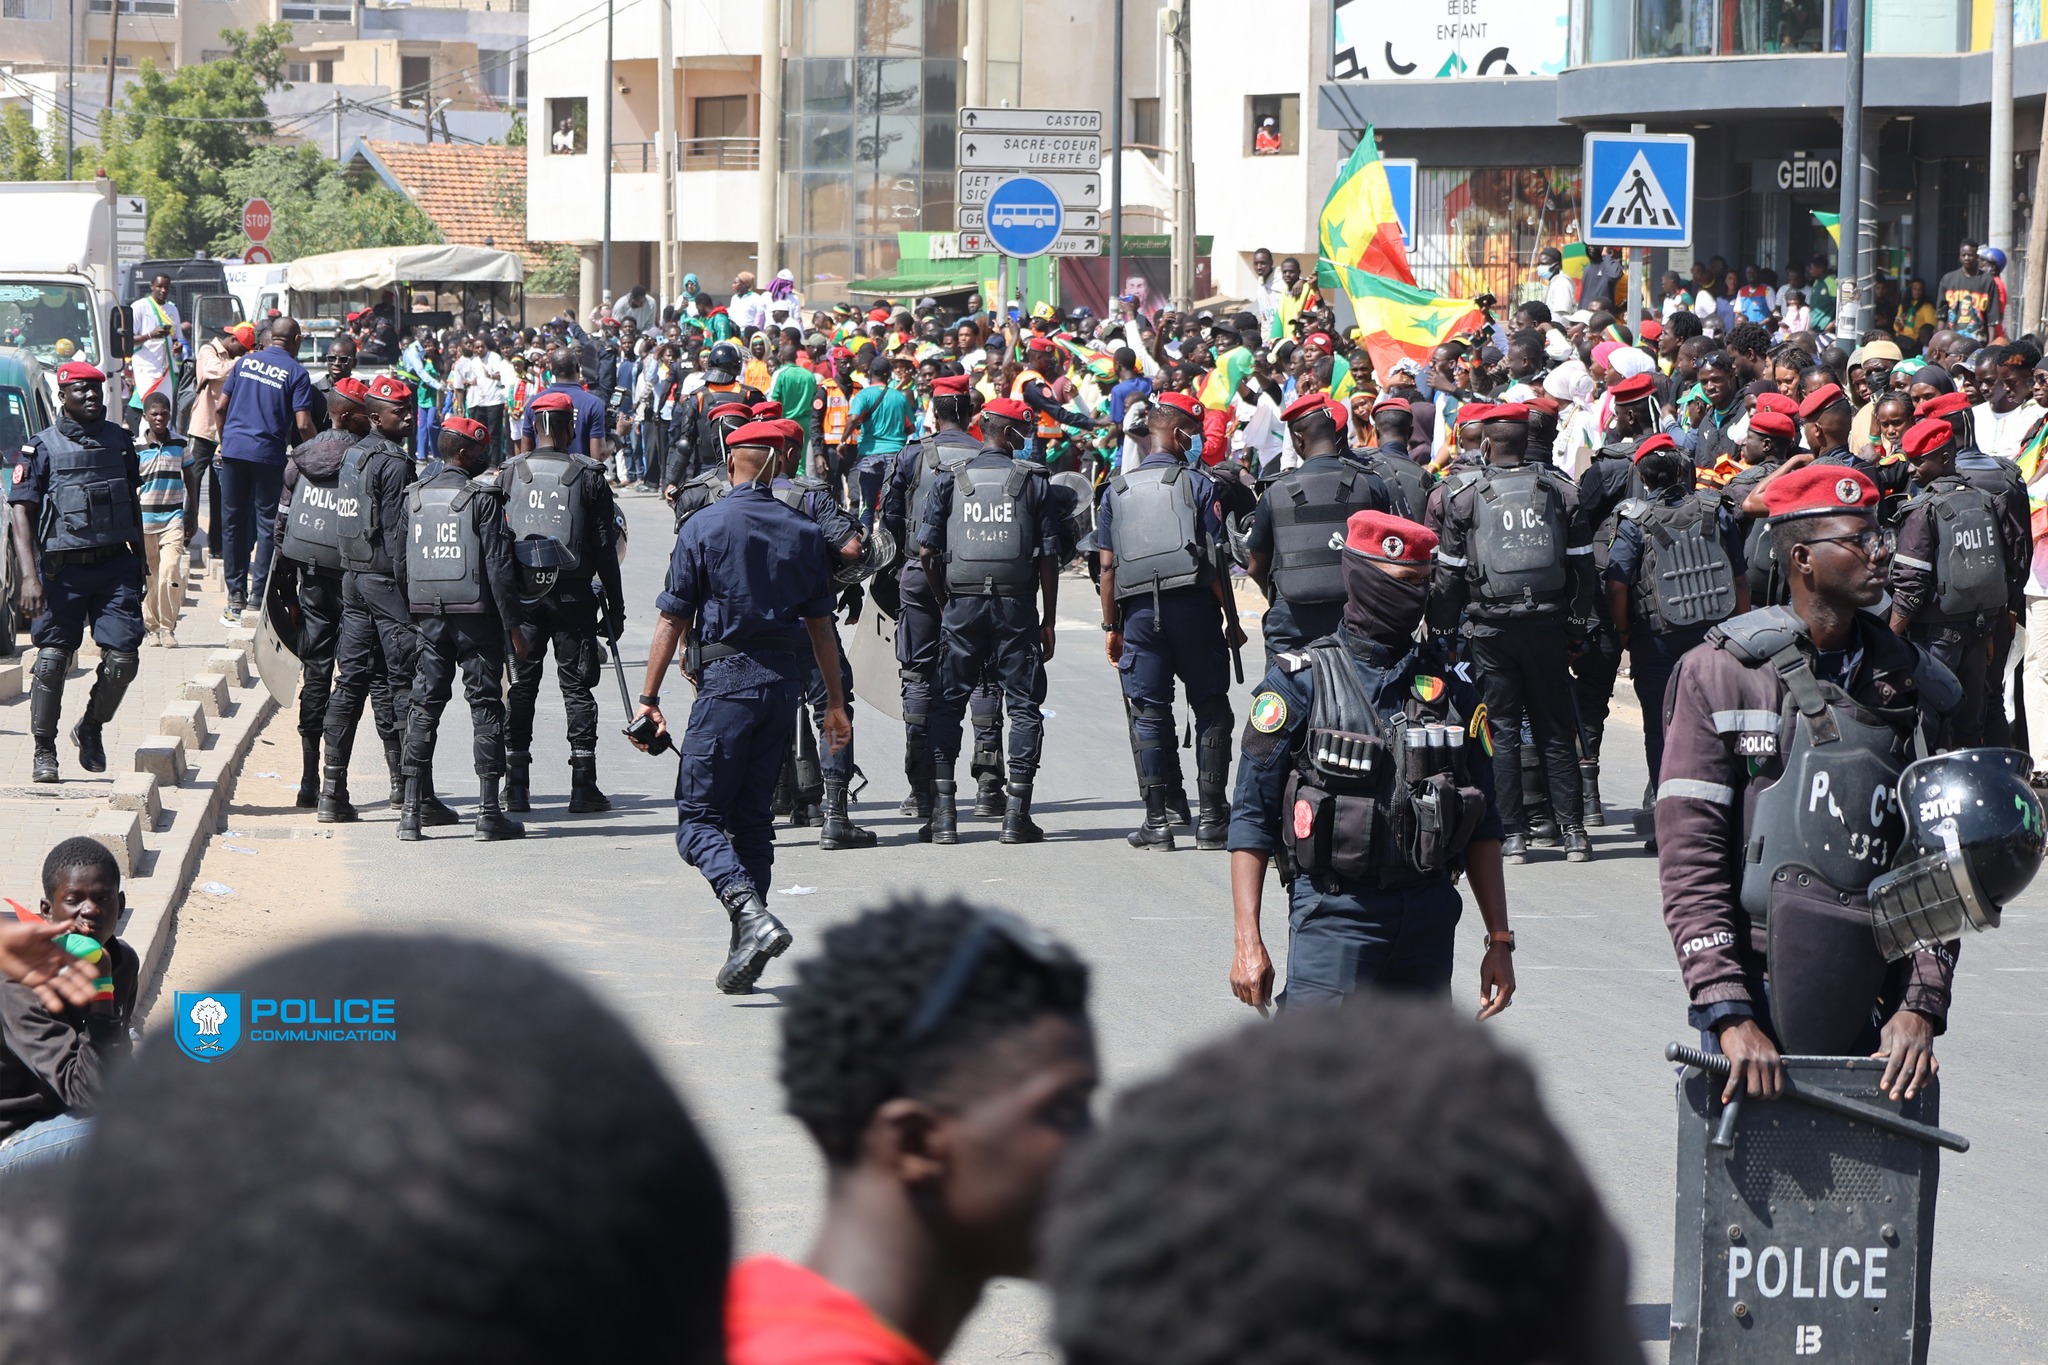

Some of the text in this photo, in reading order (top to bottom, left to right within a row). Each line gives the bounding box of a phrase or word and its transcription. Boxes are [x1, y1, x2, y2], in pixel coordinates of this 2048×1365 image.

[1437, 23, 1488, 39] ENFANT
[1046, 116, 1097, 127] CASTOR
[1003, 137, 1097, 150] SACRÉ-COEUR
[1029, 151, 1096, 164] LIBERTÉ 6
[966, 176, 990, 187] JET
[246, 214, 270, 227] STOP
[241, 358, 289, 381] POLICE
[239, 371, 283, 390] COMMUNICATION
[1727, 1245, 1889, 1299] POLICE
